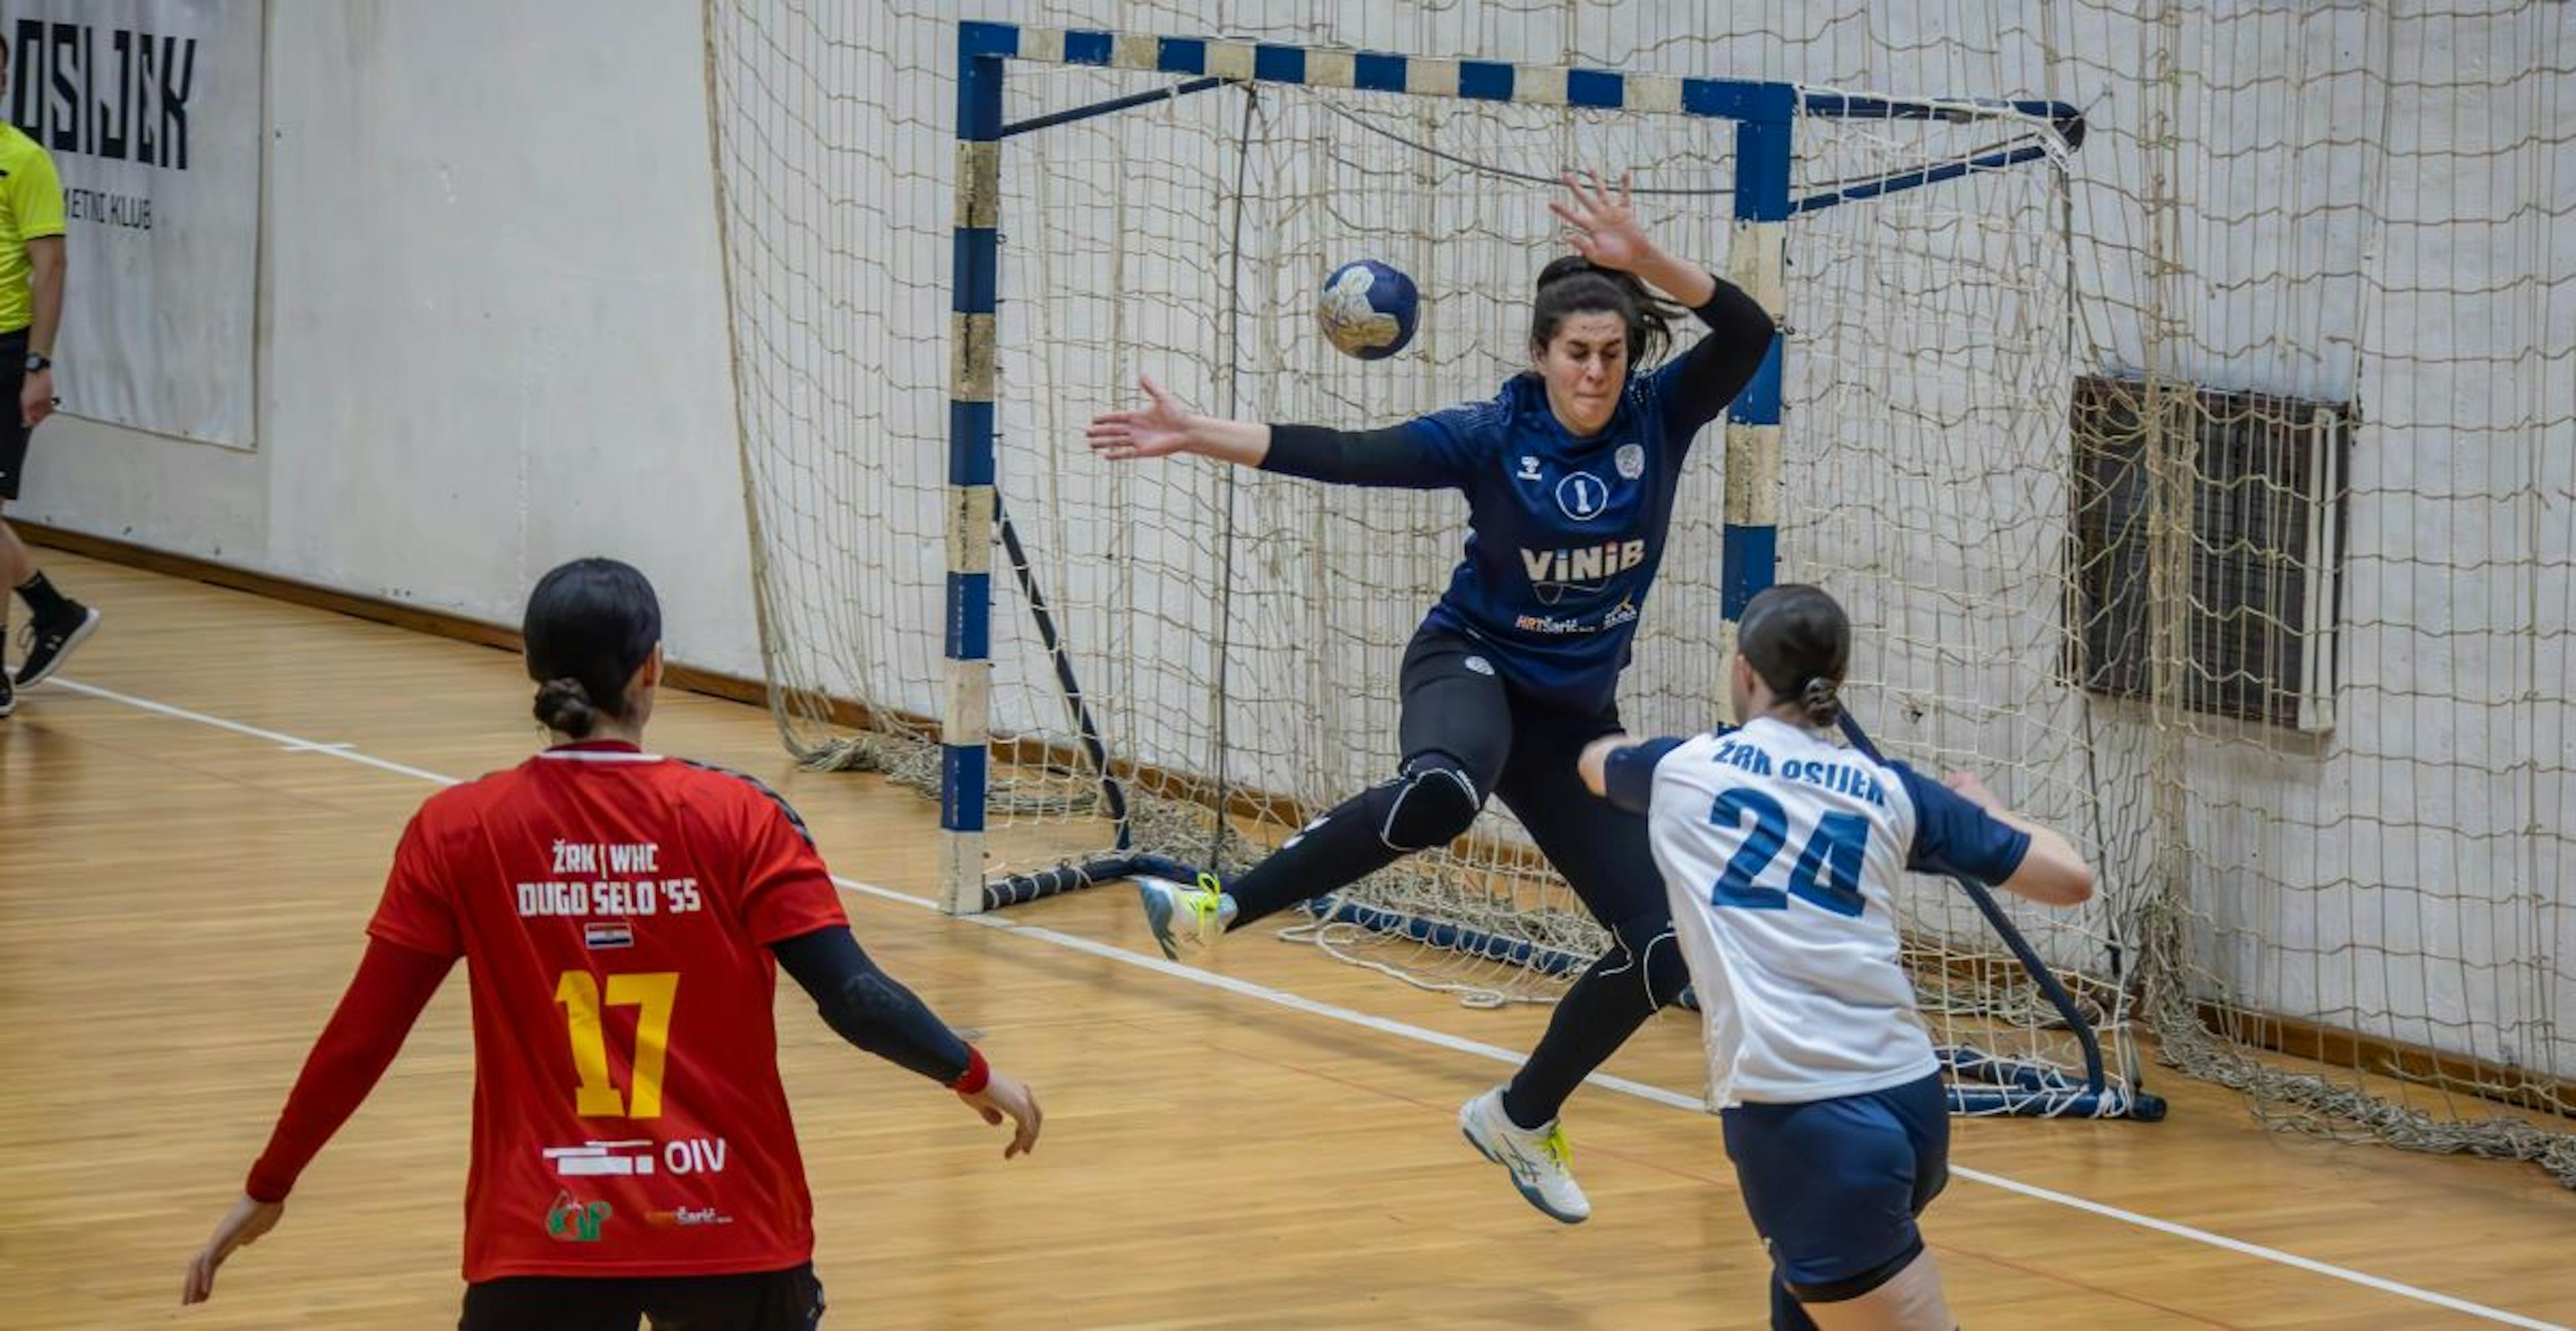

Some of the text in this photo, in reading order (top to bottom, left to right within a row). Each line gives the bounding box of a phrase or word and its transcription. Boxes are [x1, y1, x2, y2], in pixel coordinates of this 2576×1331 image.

[12, 19, 196, 170] OSIJEK
[111, 193, 152, 229] KLUB
[1574, 479, 1592, 513] 1
[552, 838, 659, 873] ŽRK WHC
[1710, 787, 1870, 918] 24
[517, 878, 702, 917] DUGO SELO '55
[554, 969, 680, 1119] 17
[664, 1137, 727, 1174] OIV
